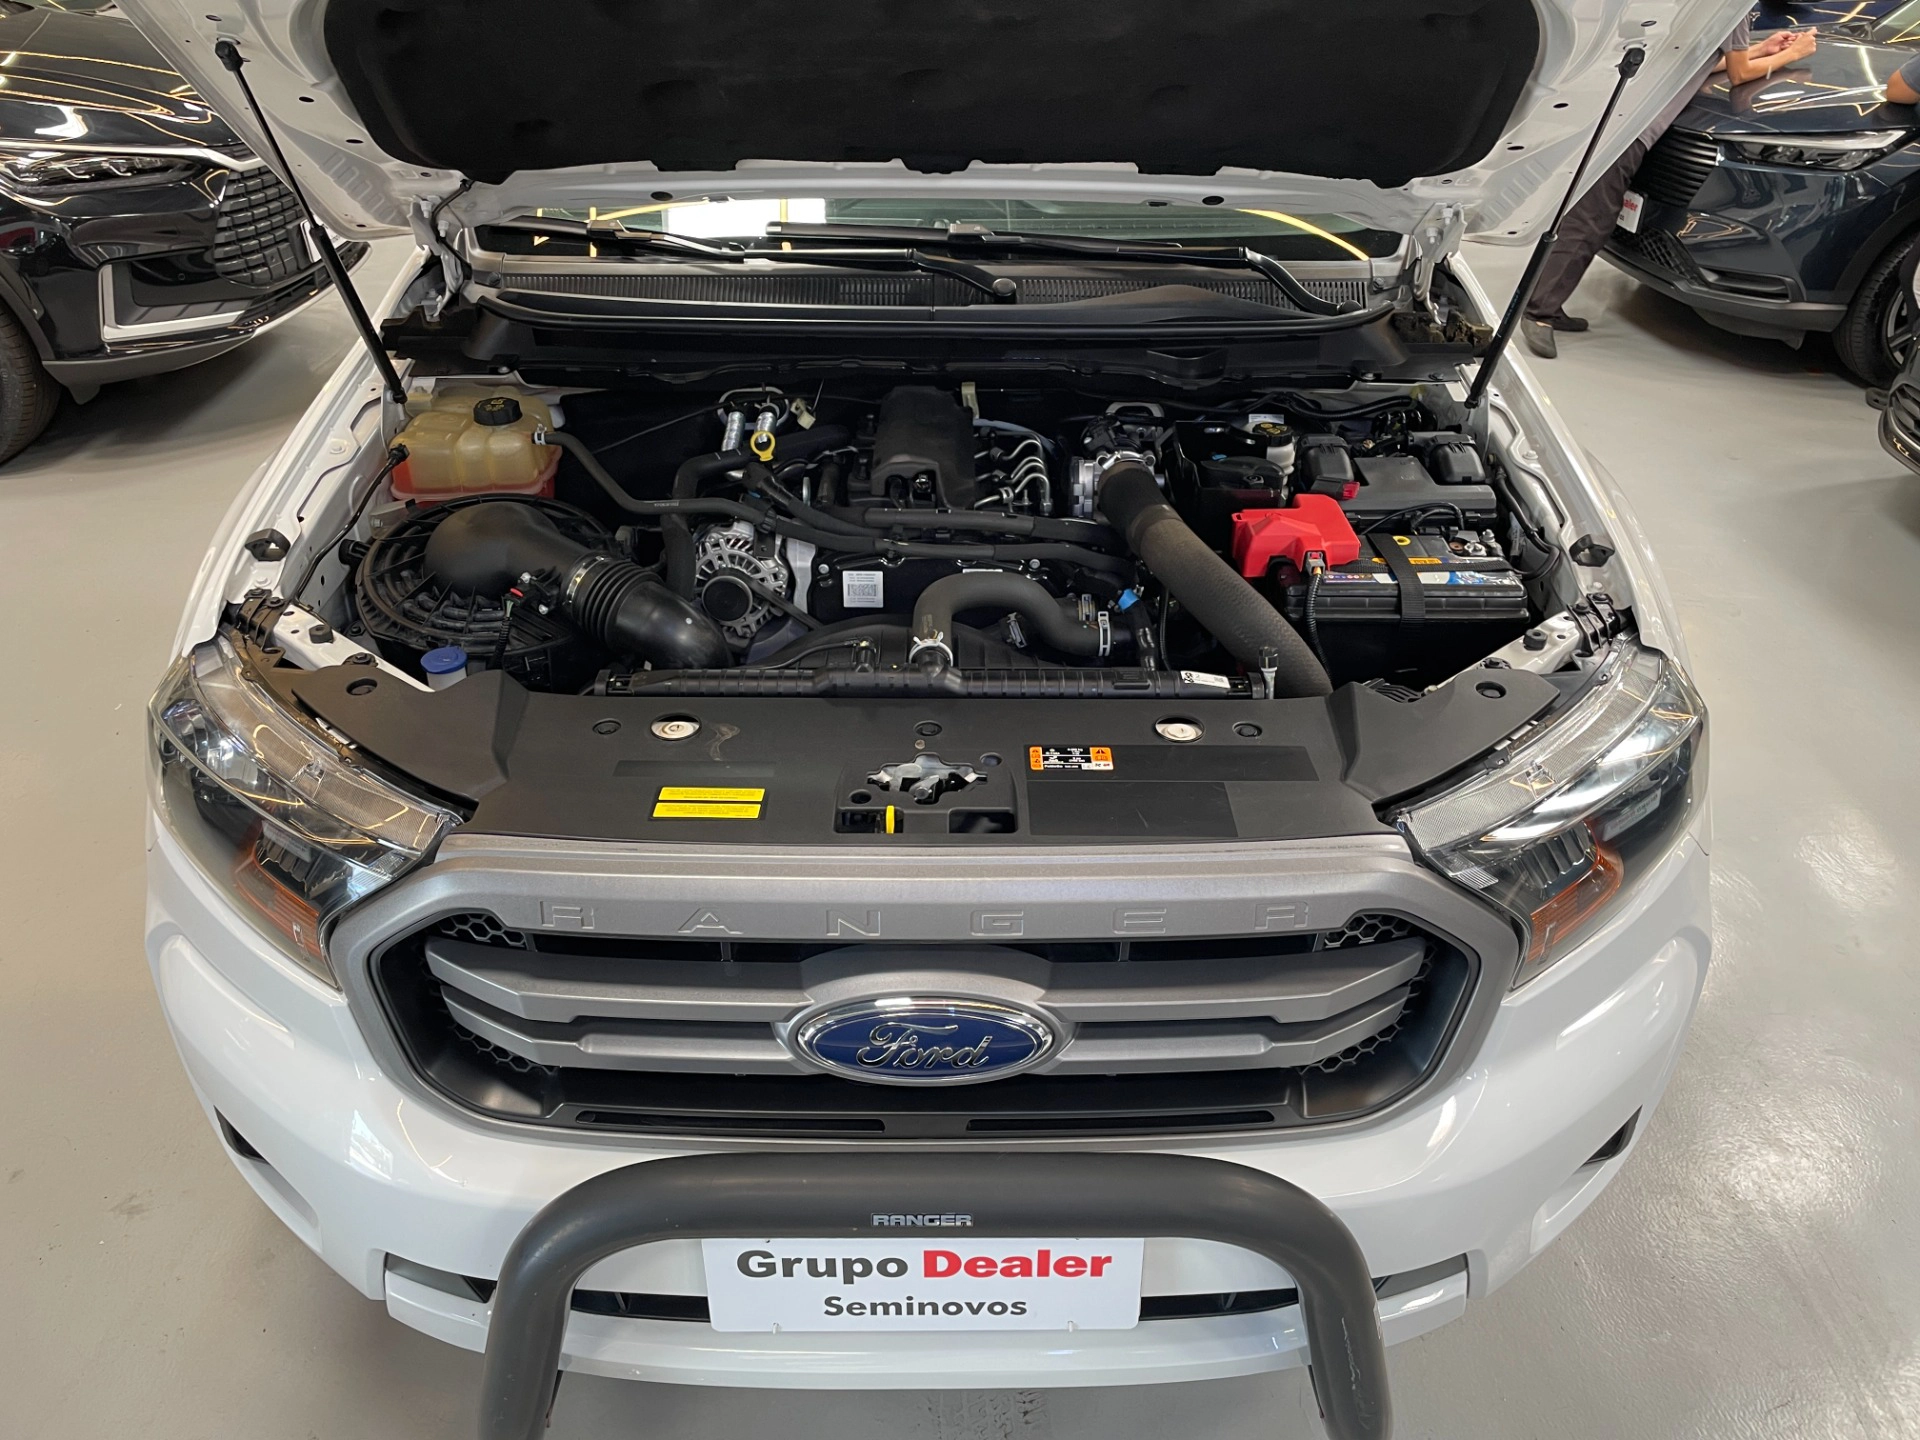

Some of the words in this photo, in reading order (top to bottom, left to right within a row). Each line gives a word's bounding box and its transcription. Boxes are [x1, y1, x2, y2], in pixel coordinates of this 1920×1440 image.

[540, 900, 1310, 936] RANGER
[856, 1021, 994, 1070] Ford
[872, 1213, 973, 1227] RANGER
[736, 1249, 909, 1285] Grupo
[923, 1249, 1113, 1278] Dealer
[823, 1295, 1028, 1317] Seminovos
